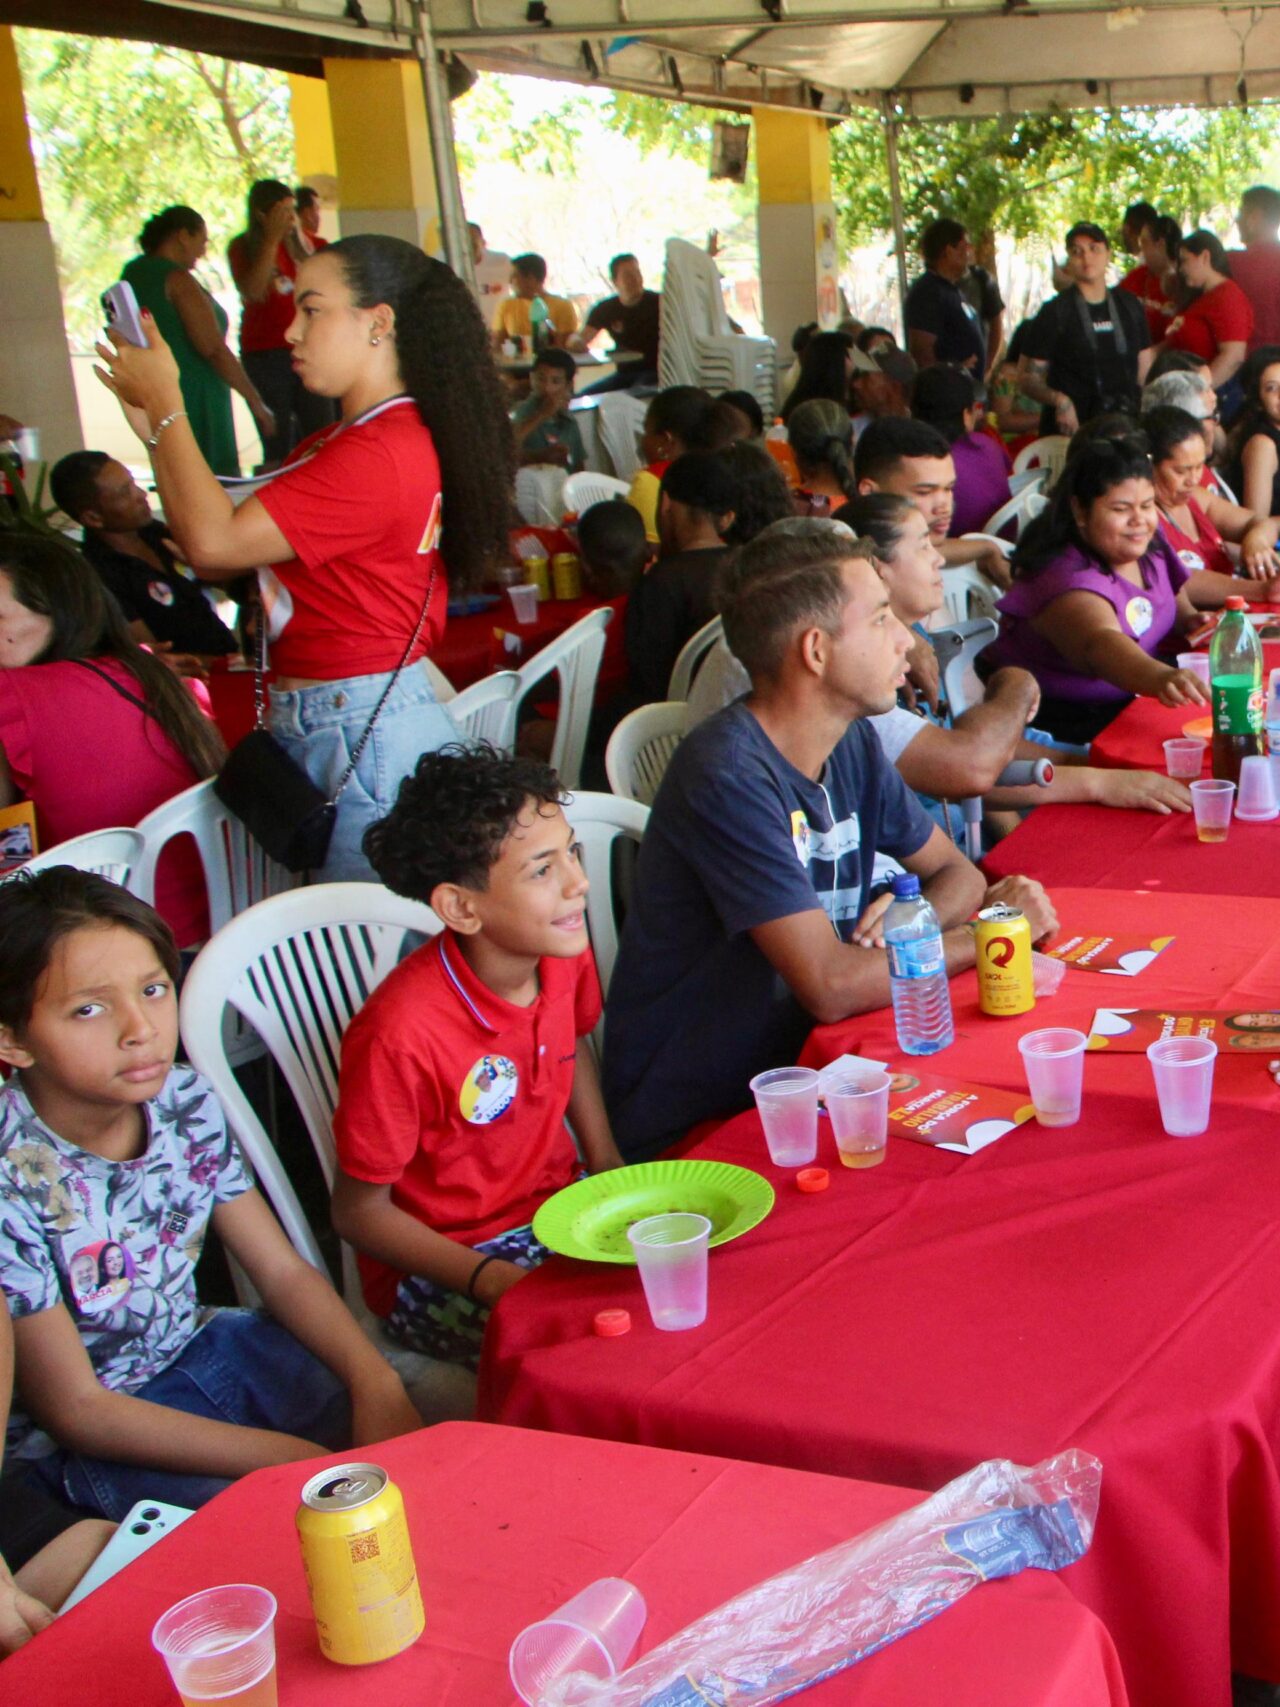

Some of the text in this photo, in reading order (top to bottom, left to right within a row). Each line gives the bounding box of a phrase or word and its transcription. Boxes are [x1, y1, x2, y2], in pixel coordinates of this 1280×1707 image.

[901, 1091, 969, 1128] TRABALHO
[932, 1100, 970, 1120] FORÇA
[917, 1120, 938, 1131] DO
